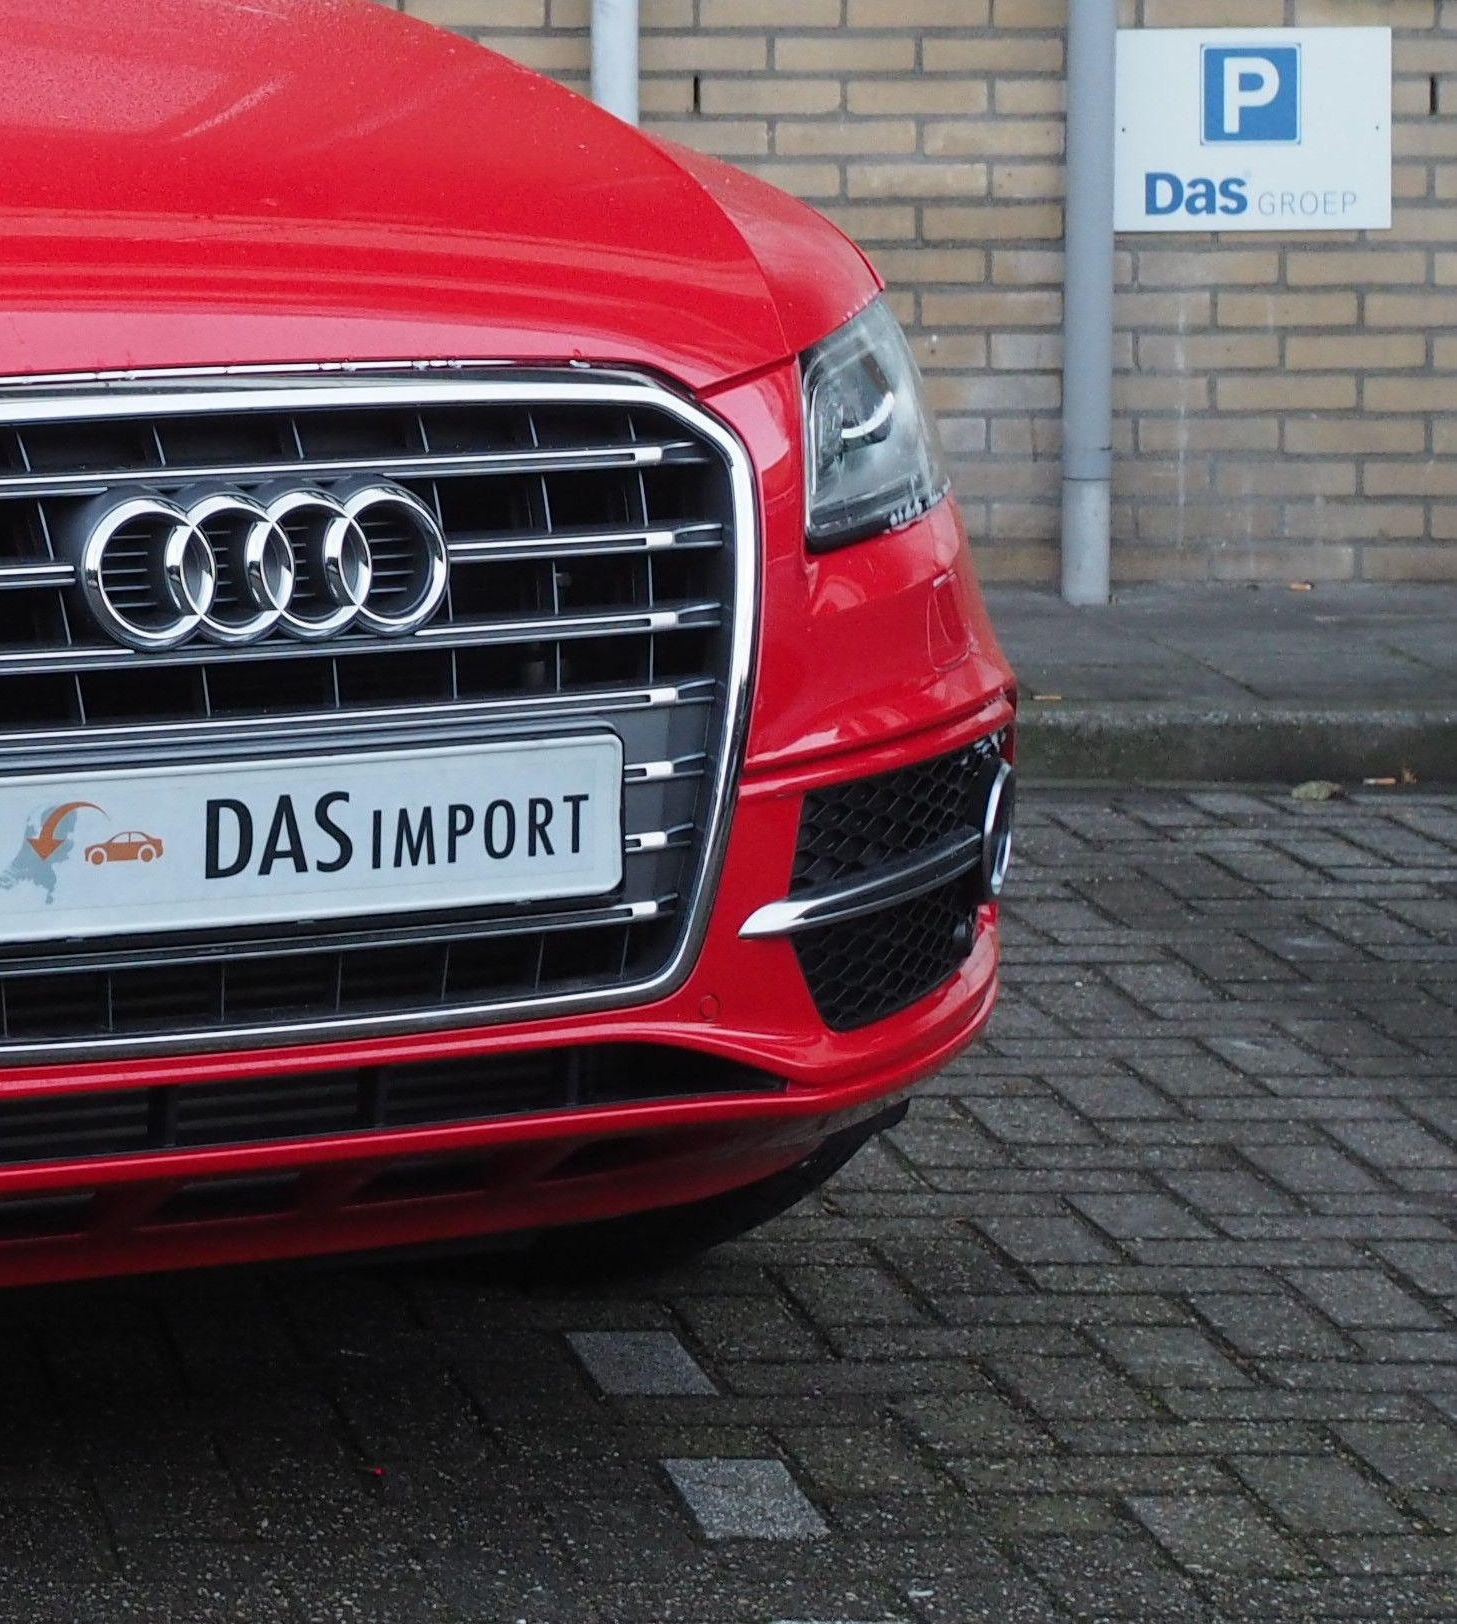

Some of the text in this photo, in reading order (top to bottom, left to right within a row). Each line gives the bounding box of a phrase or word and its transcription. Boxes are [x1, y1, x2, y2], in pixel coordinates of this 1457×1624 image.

[1224, 57, 1279, 134] P
[1258, 192, 1357, 215] GROEP
[205, 791, 589, 879] DAS IMPORT
